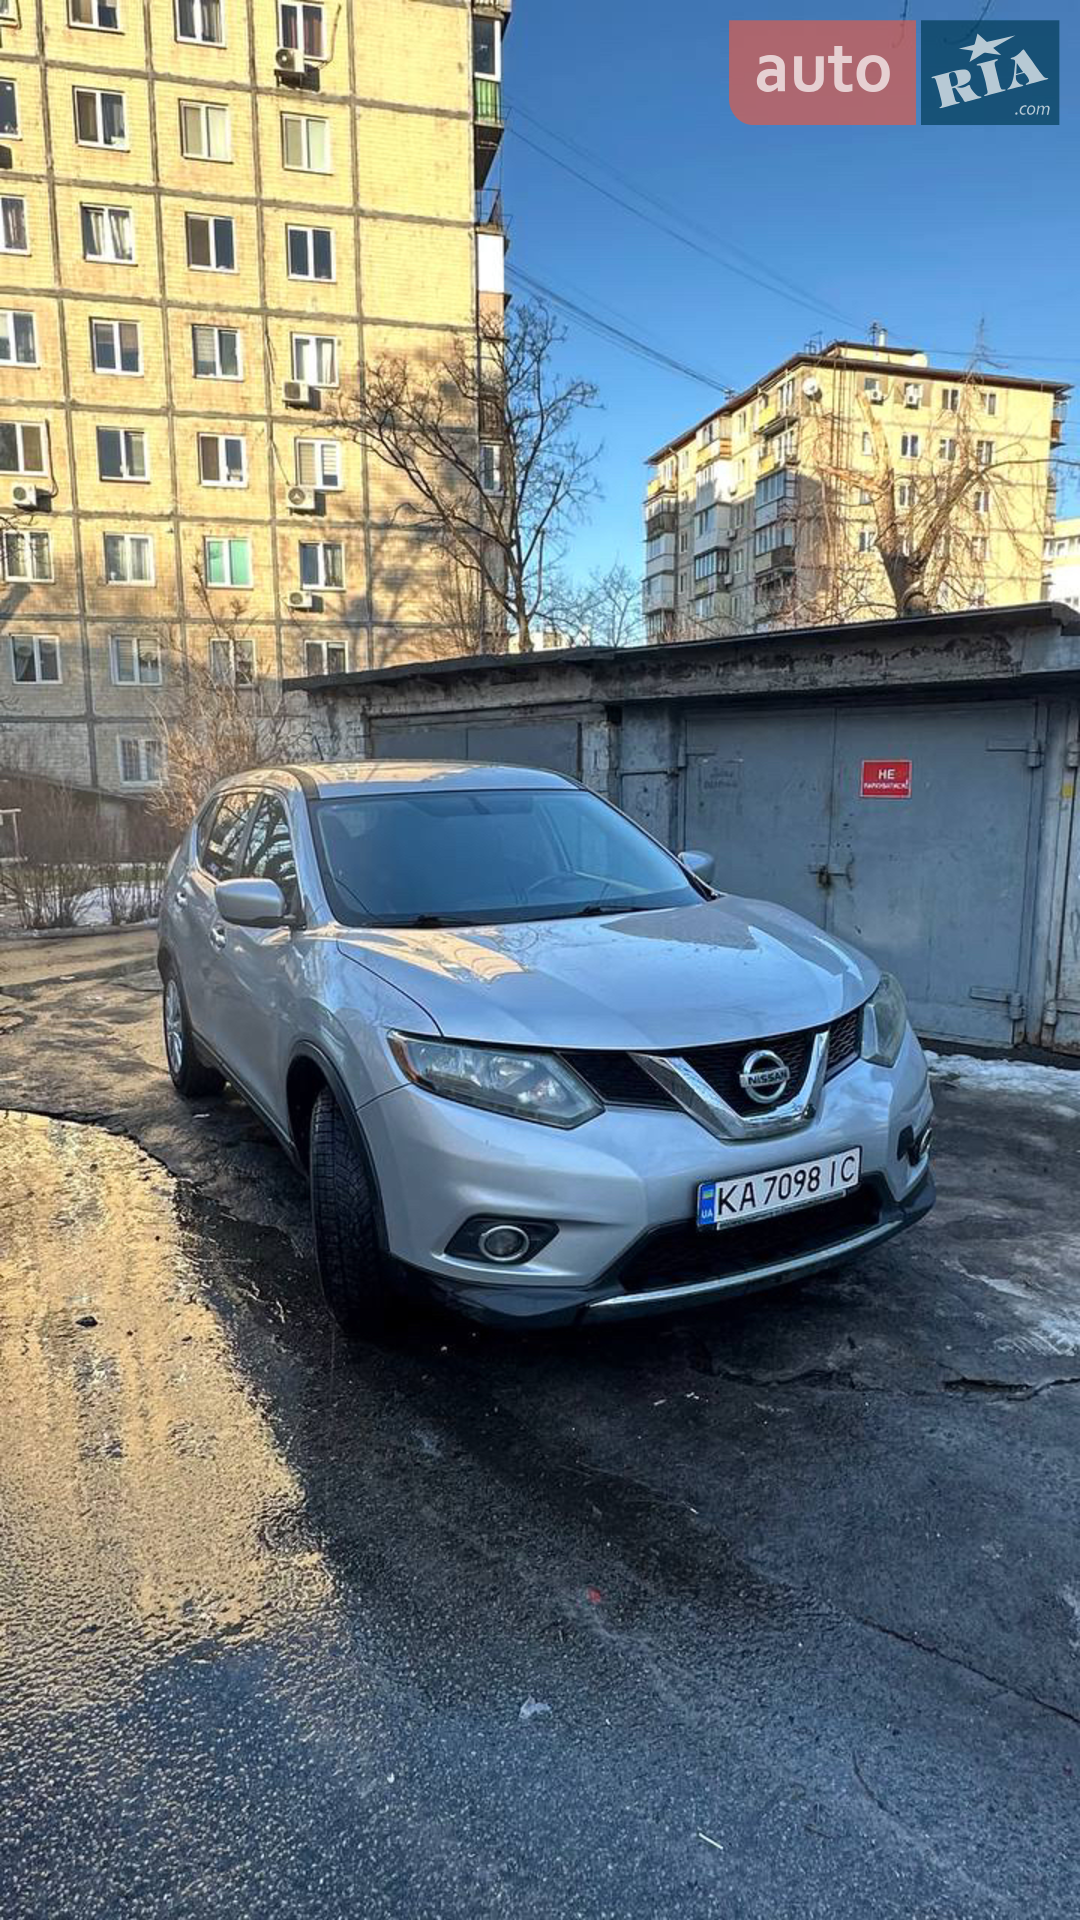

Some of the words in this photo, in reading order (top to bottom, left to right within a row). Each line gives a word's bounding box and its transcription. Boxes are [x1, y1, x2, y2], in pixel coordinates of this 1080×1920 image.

[878, 768, 896, 780] НЕ
[748, 1069, 787, 1085] NISSAN
[718, 1181, 756, 1215] KA
[763, 1166, 820, 1205] 7098
[830, 1155, 855, 1187] IC
[701, 1209, 713, 1219] UA
